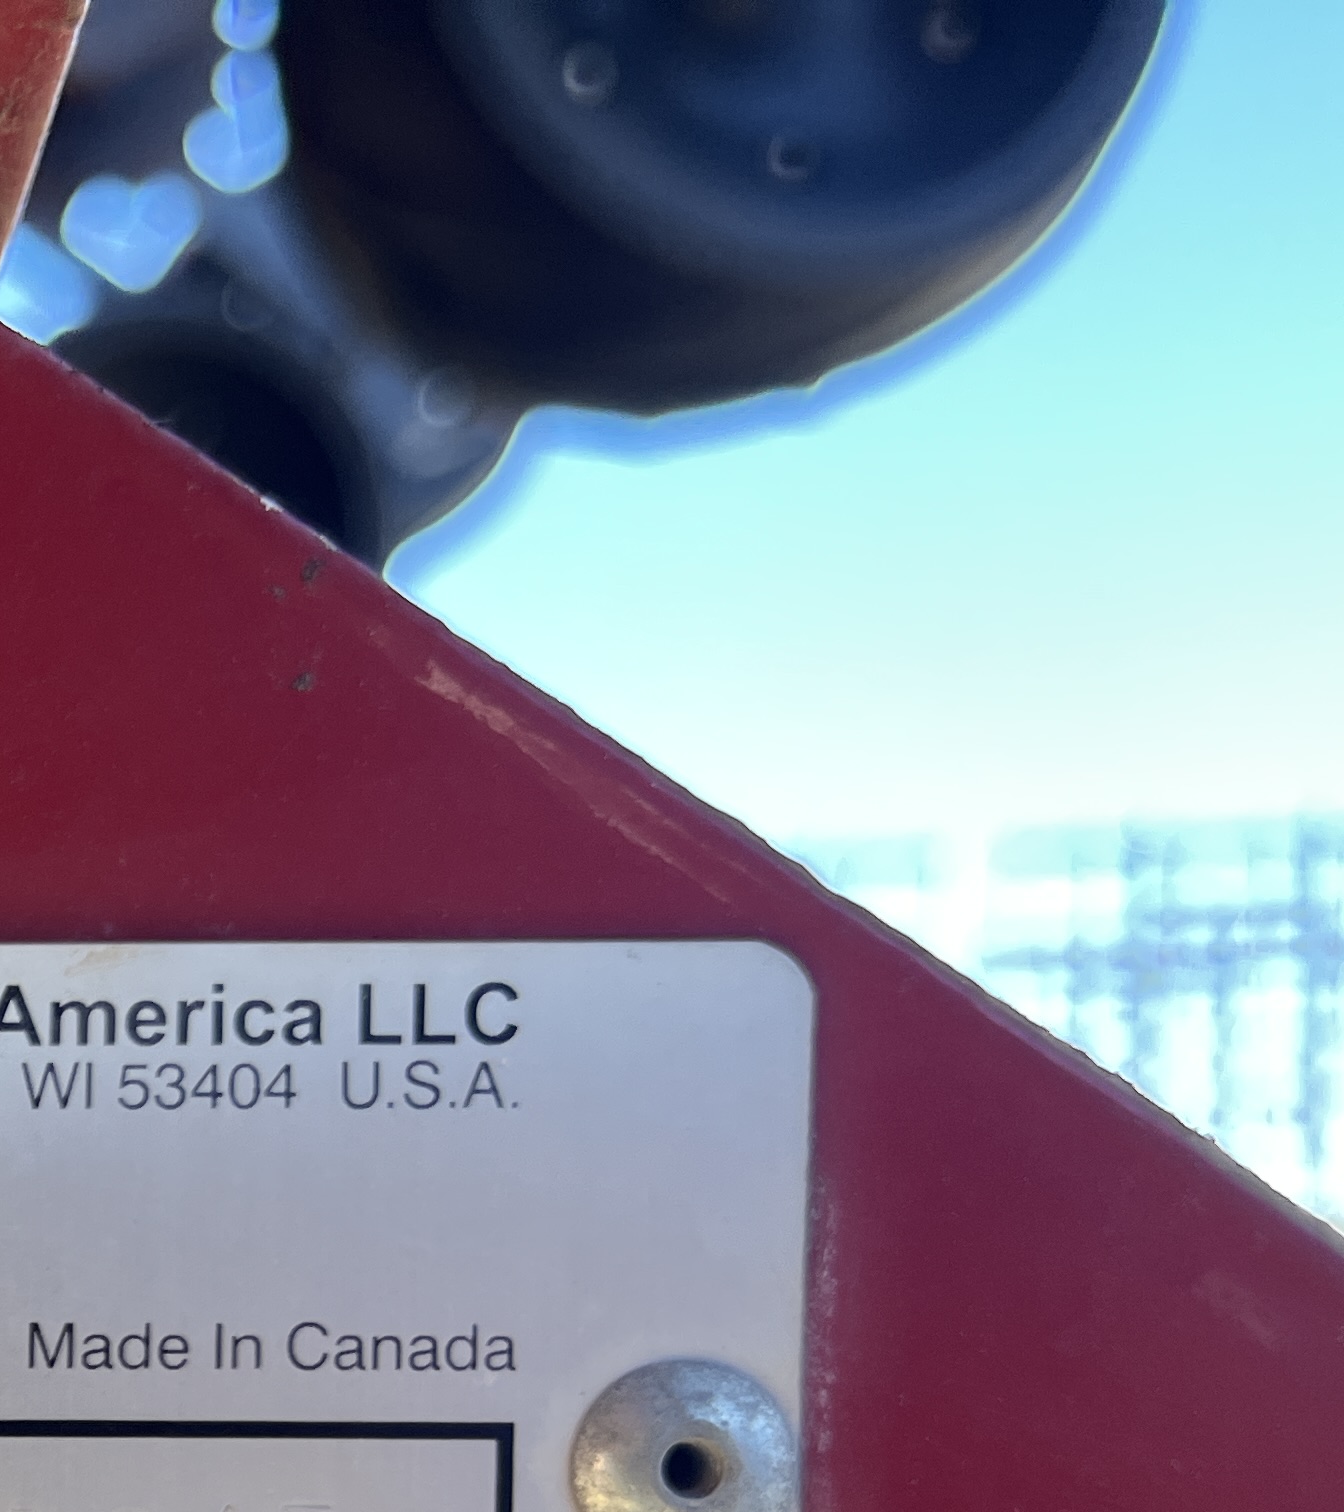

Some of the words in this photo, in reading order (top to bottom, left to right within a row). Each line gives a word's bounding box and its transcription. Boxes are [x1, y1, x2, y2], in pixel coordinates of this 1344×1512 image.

[357, 981, 521, 1047] LLC
[20, 1062, 95, 1112] WI
[116, 1061, 299, 1112] 53404
[339, 1059, 521, 1112] U.S.A.
[26, 1321, 190, 1373] Made
[213, 1321, 263, 1373] In
[285, 1320, 517, 1374] Canada
